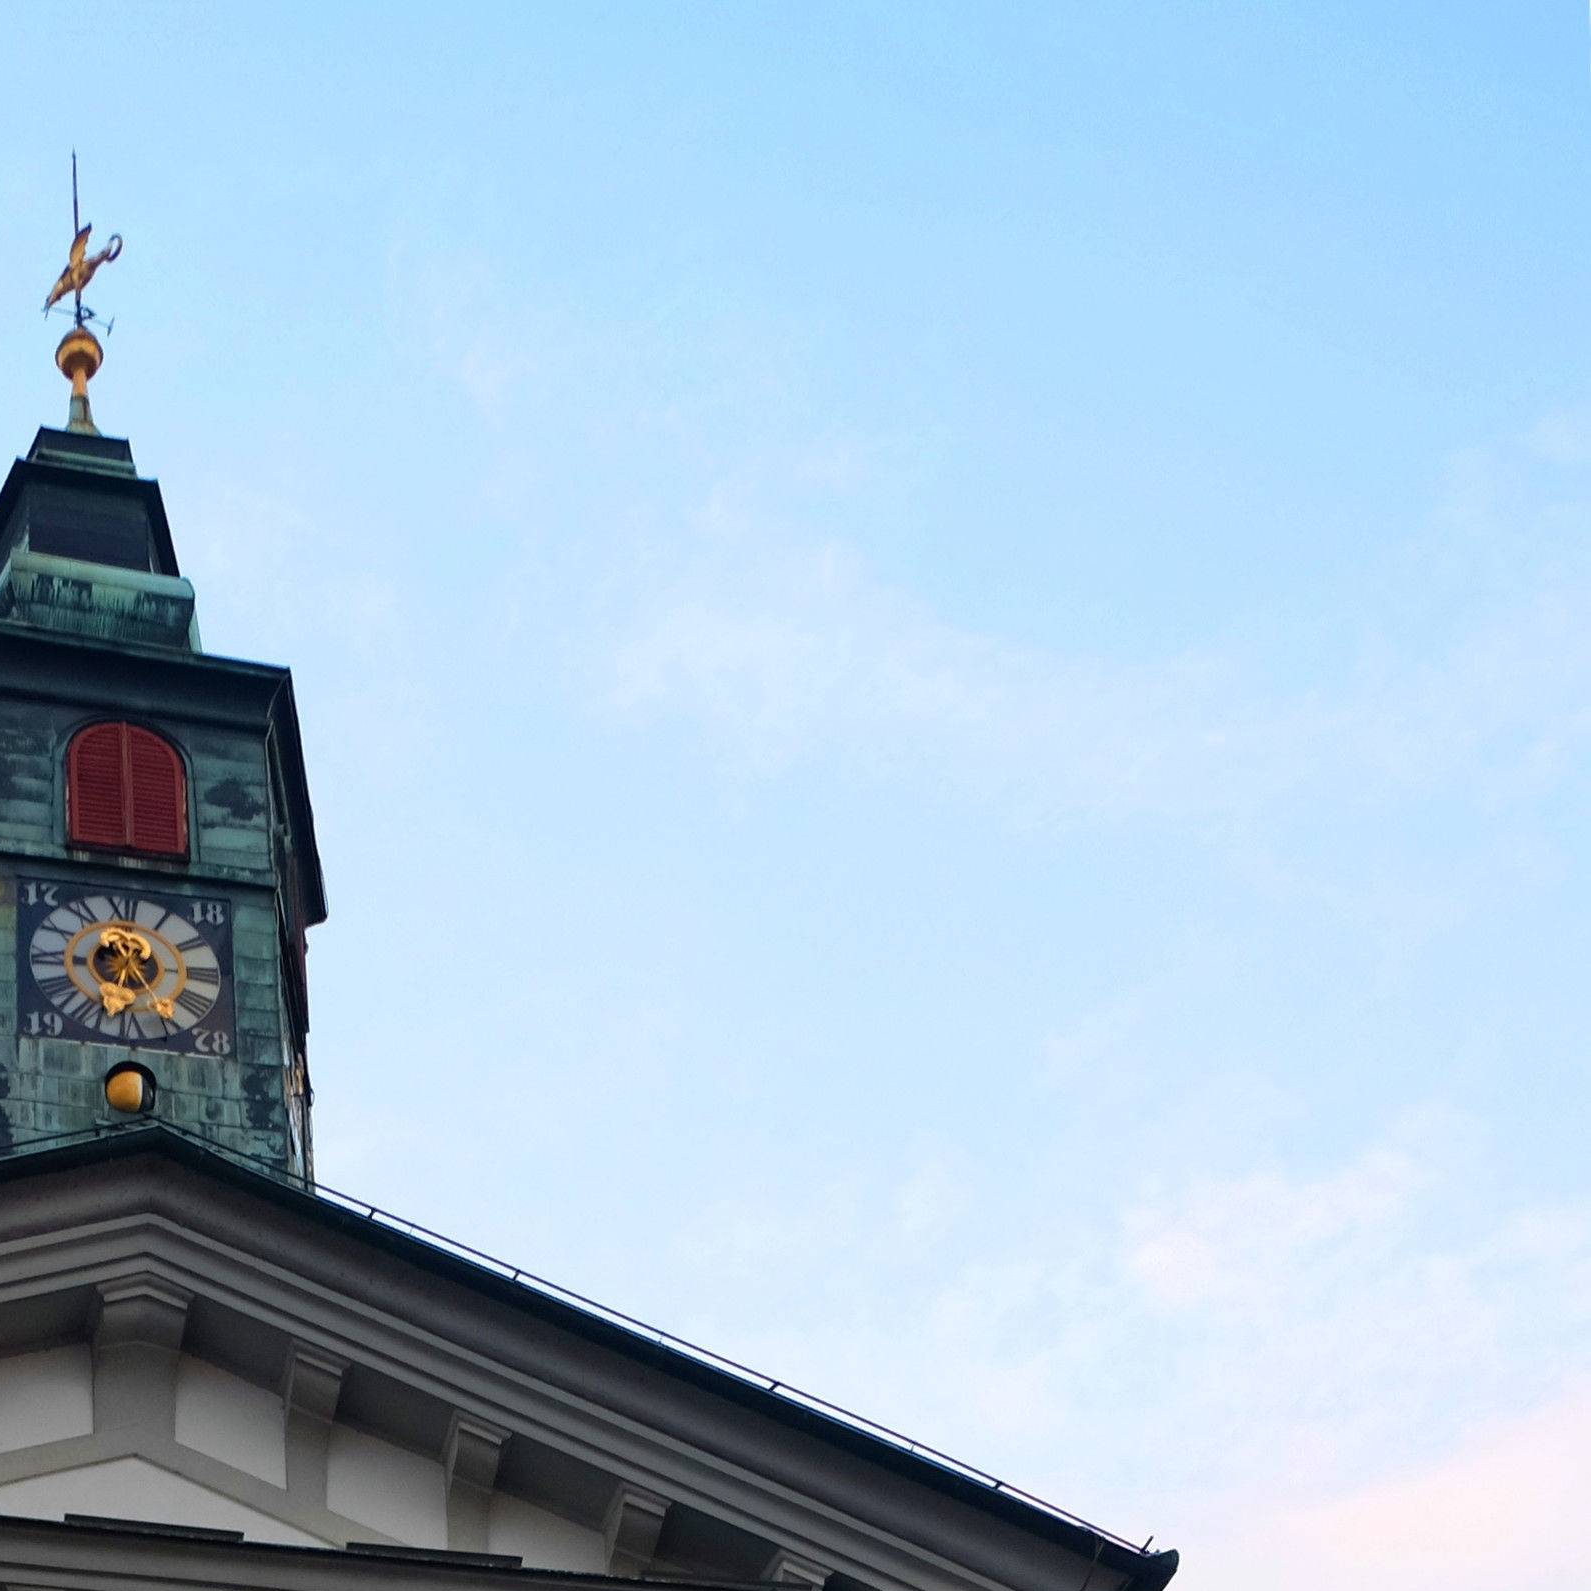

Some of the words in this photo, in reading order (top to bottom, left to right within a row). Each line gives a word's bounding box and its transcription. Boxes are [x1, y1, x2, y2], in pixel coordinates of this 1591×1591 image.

[22, 882, 59, 906] 17
[187, 901, 224, 925] 18
[23, 1012, 63, 1036] 19
[191, 1028, 231, 1054] 28
